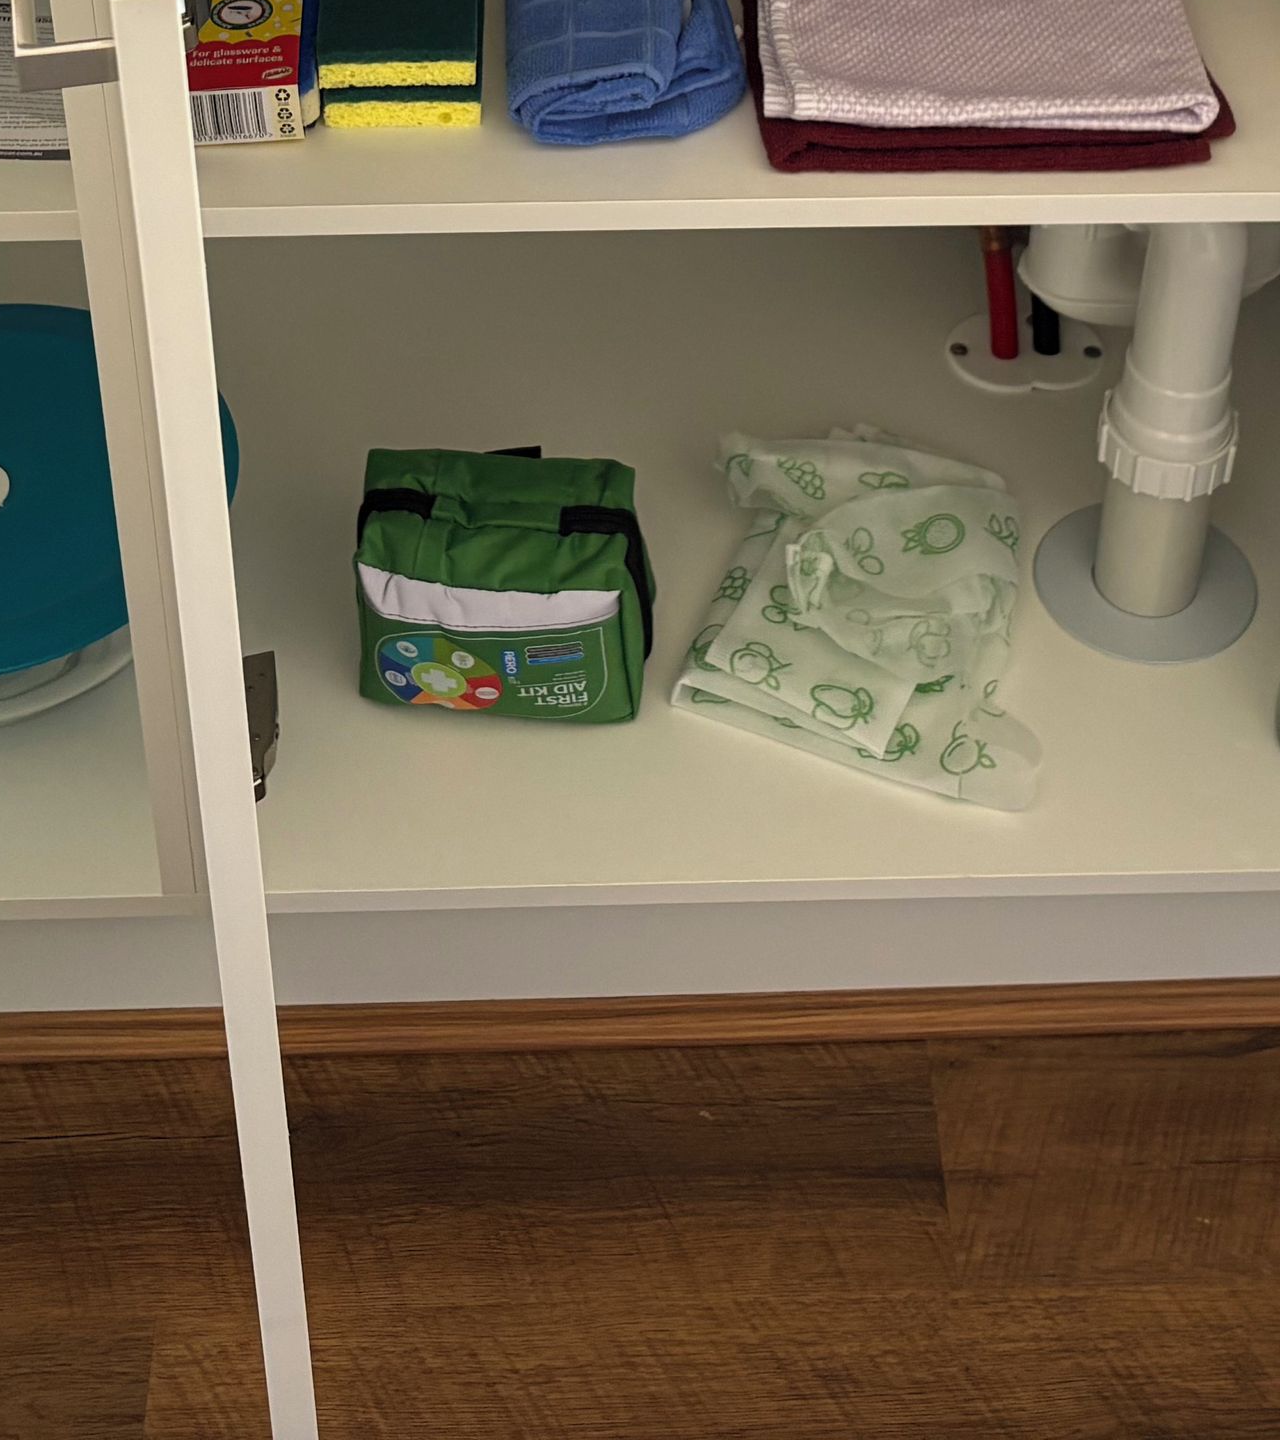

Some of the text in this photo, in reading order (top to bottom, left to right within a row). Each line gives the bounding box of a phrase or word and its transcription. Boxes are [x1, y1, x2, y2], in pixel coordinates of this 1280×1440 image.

[192, 45, 282, 58] For glassware &
[189, 55, 283, 67] delicate surfaces
[516, 680, 587, 697] AID KIT
[534, 691, 588, 706] FIRST
